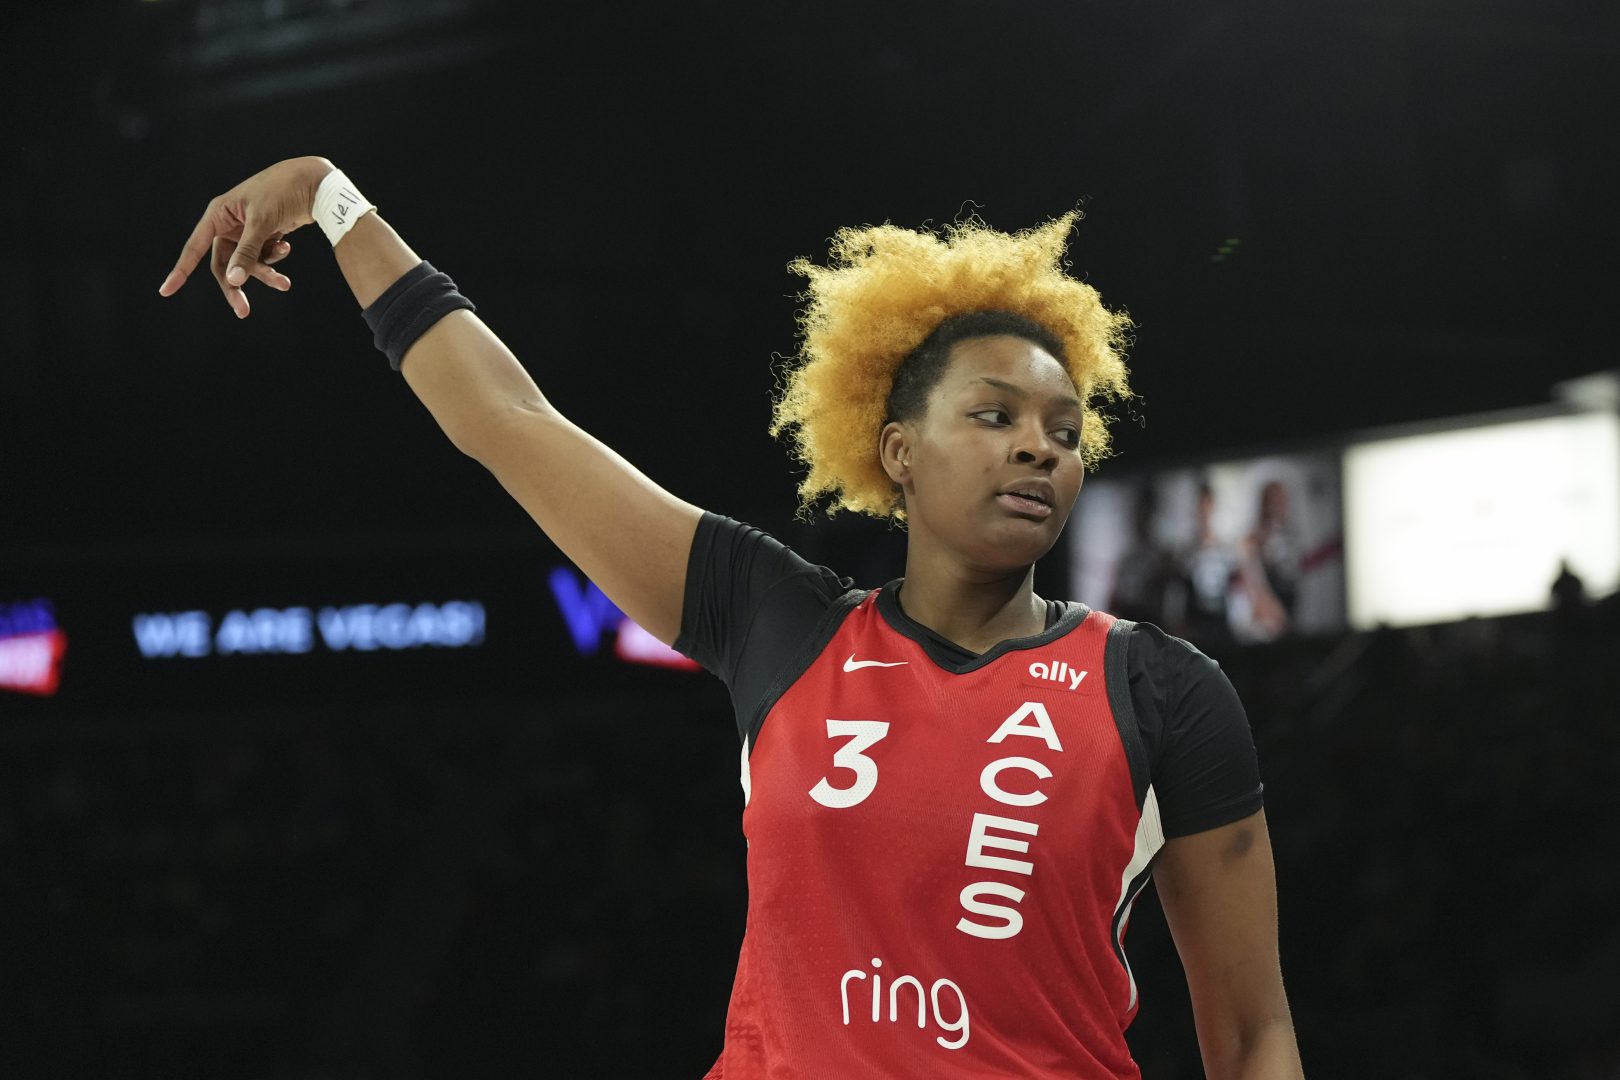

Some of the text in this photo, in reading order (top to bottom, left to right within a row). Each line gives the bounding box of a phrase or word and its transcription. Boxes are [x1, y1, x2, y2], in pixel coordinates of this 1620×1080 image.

[134, 611, 210, 656] WE
[217, 607, 312, 653] ARE
[1028, 660, 1088, 691] ally
[808, 719, 890, 808] 3
[956, 701, 1064, 940] ACES
[840, 957, 970, 1050] ring
